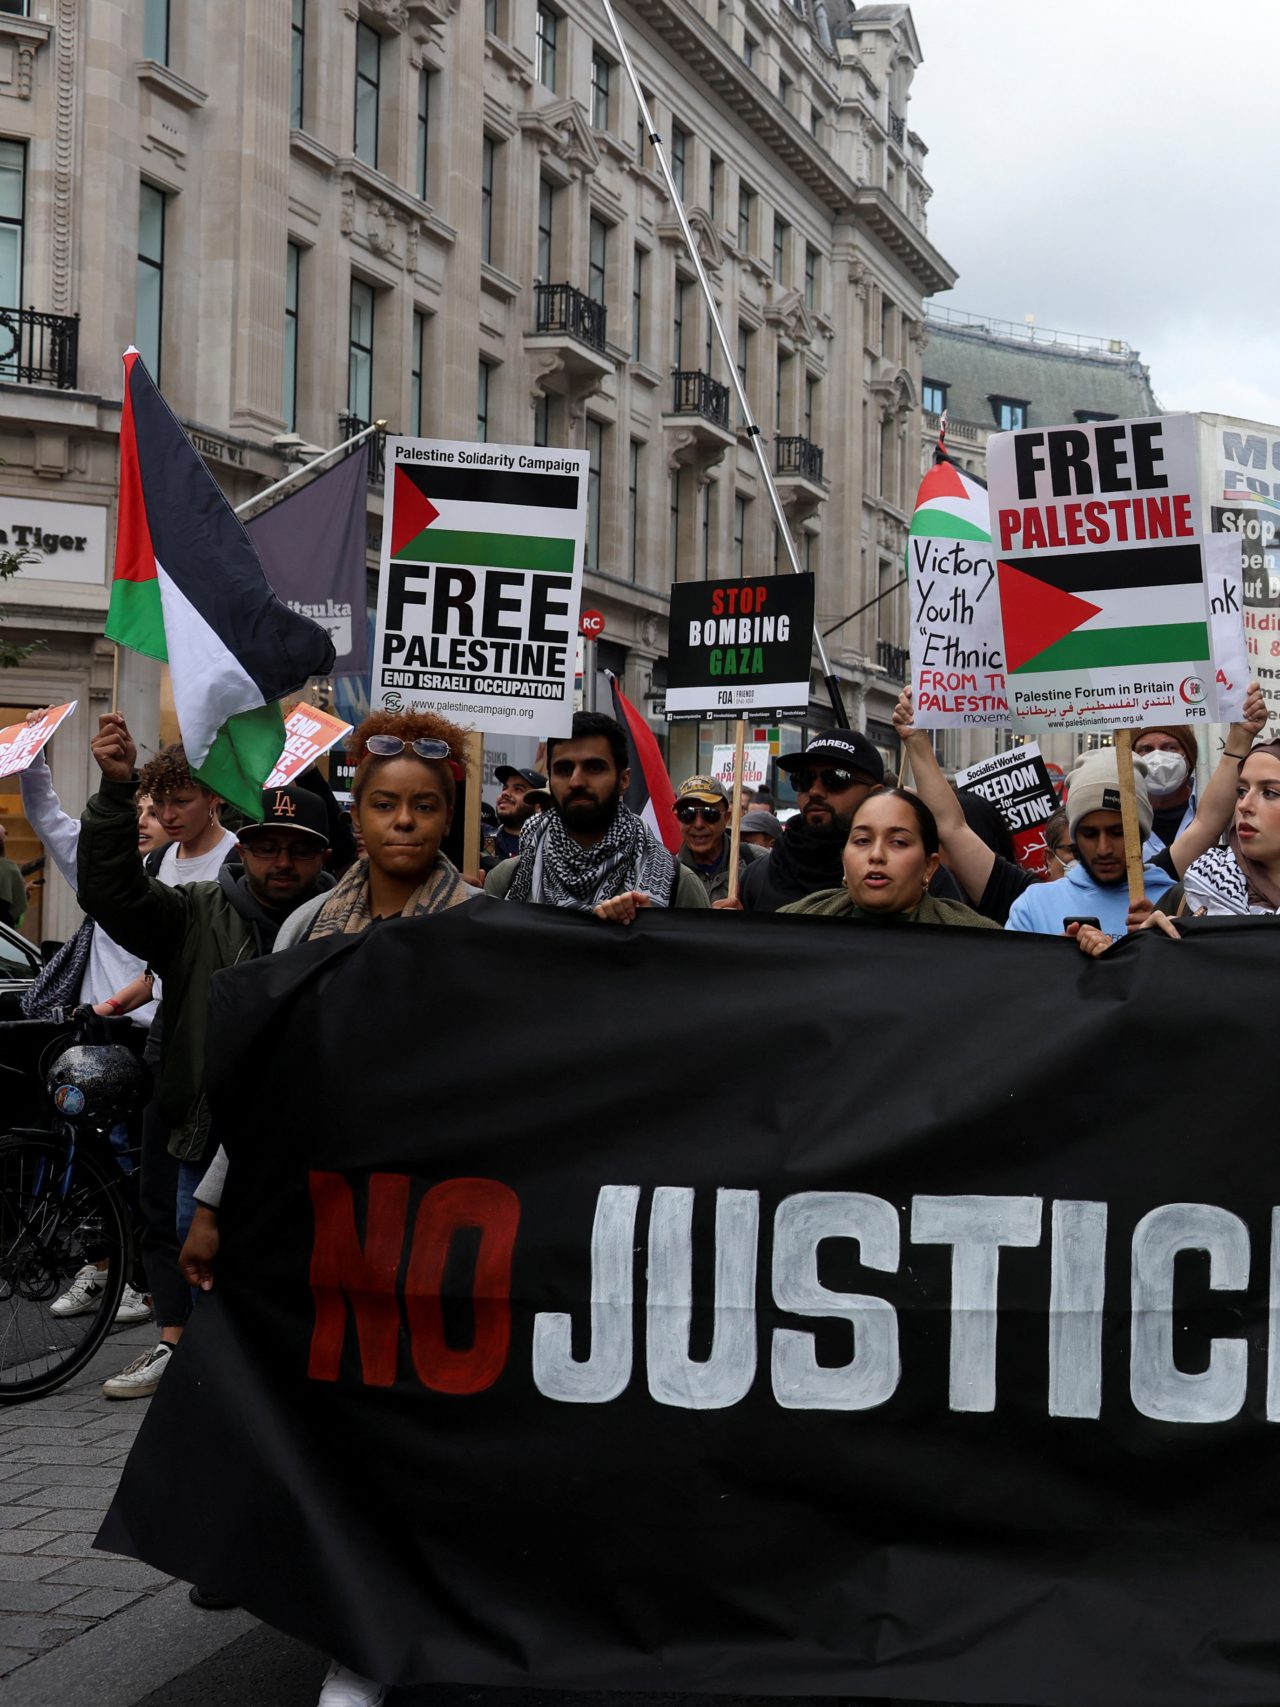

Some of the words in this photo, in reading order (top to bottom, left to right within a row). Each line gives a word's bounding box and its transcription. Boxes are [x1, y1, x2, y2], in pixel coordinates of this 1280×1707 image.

[395, 446, 455, 463] Palestine
[457, 451, 516, 469] Solidarity
[519, 456, 580, 473] Campaign
[1014, 422, 1169, 500] FREE
[998, 494, 1194, 551] PALESTINE
[1222, 511, 1275, 547] Stop
[12, 525, 87, 554] Tiger
[914, 539, 995, 602] Victory
[385, 563, 572, 644] FREE
[712, 586, 767, 615] STOP
[915, 579, 974, 624] Youth
[583, 618, 600, 629] RC
[689, 615, 790, 647] BOMBING
[382, 633, 567, 678] PALESTINE
[709, 647, 764, 675] GAZA
[384, 671, 414, 688] END
[418, 674, 470, 692] ISRAELI
[474, 678, 562, 699] OCCUPATION
[919, 670, 978, 692] FROM
[1015, 689, 1072, 703] Palestine
[1075, 687, 1116, 698] Forum
[1119, 684, 1130, 695] in
[1134, 681, 1175, 694] Britain
[385, 699, 400, 708] PSC
[411, 700, 534, 719] www.palestinecampaign.org
[718, 690, 733, 704] FOA
[918, 692, 1008, 712] PALESTIN
[1059, 702, 1074, 718] في
[1076, 697, 1139, 719] الفلسطيني
[283, 712, 324, 738] END
[1016, 705, 1057, 719] بريطانيا
[1048, 714, 1144, 729] www.palestinianforum.org.uk
[1185, 707, 1206, 718] PFB
[967, 762, 998, 781] Socialist
[998, 751, 1027, 769] Worker
[273, 790, 296, 817] LA
[1000, 797, 1013, 809] for
[307, 1170, 521, 1395] NO
